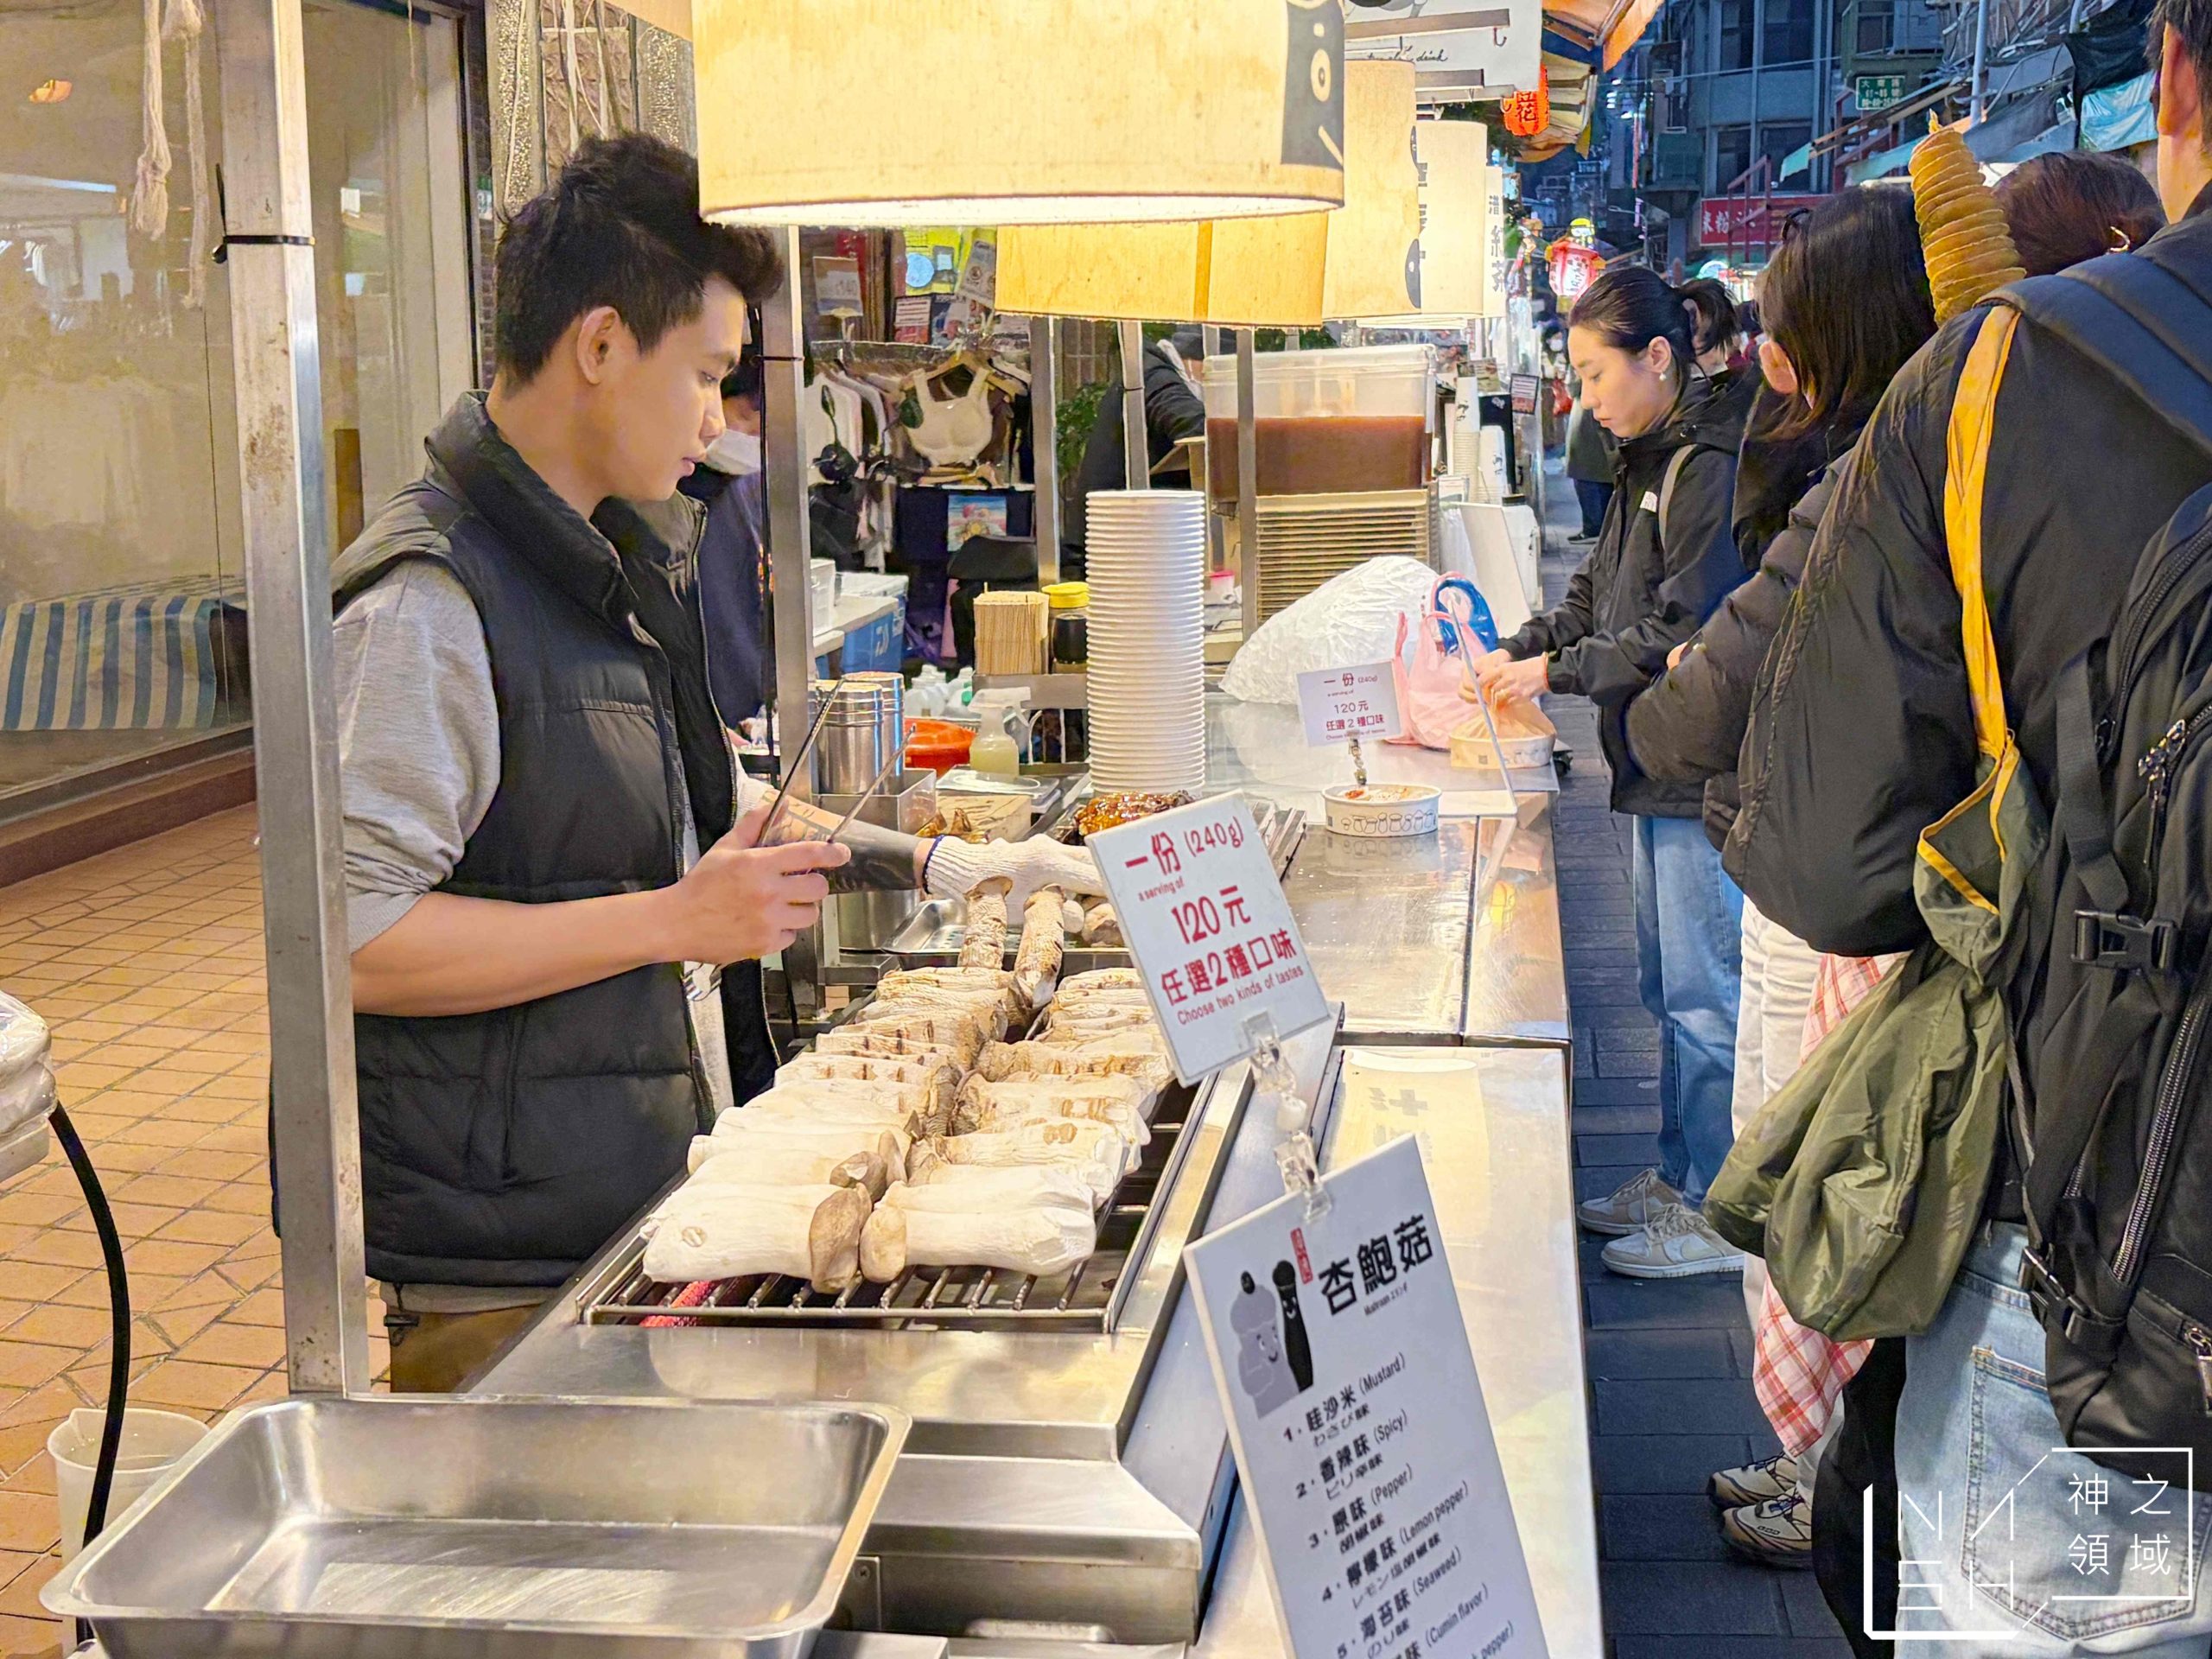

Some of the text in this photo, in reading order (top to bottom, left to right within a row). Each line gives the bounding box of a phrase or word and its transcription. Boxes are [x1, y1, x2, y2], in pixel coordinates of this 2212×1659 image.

[1125, 816, 1246, 876] 一份 (240g)
[1144, 880, 1177, 900] serving
[1175, 875, 1185, 889] of
[1160, 927, 1297, 1007] 任選2種口味
[1177, 965, 1305, 1026] Choose two kinds of tastes
[1319, 1213, 1433, 1316] 杏鮑菇
[1358, 1351, 1406, 1395] (Mustard)
[1373, 1408, 1408, 1446] (Spicy)
[1371, 1462, 1413, 1507] (Pepper)
[1399, 1510, 1434, 1546] (Lemon
[1433, 1479, 1469, 1522] pepper)
[1413, 1545, 1462, 1598] (Seaweed)
